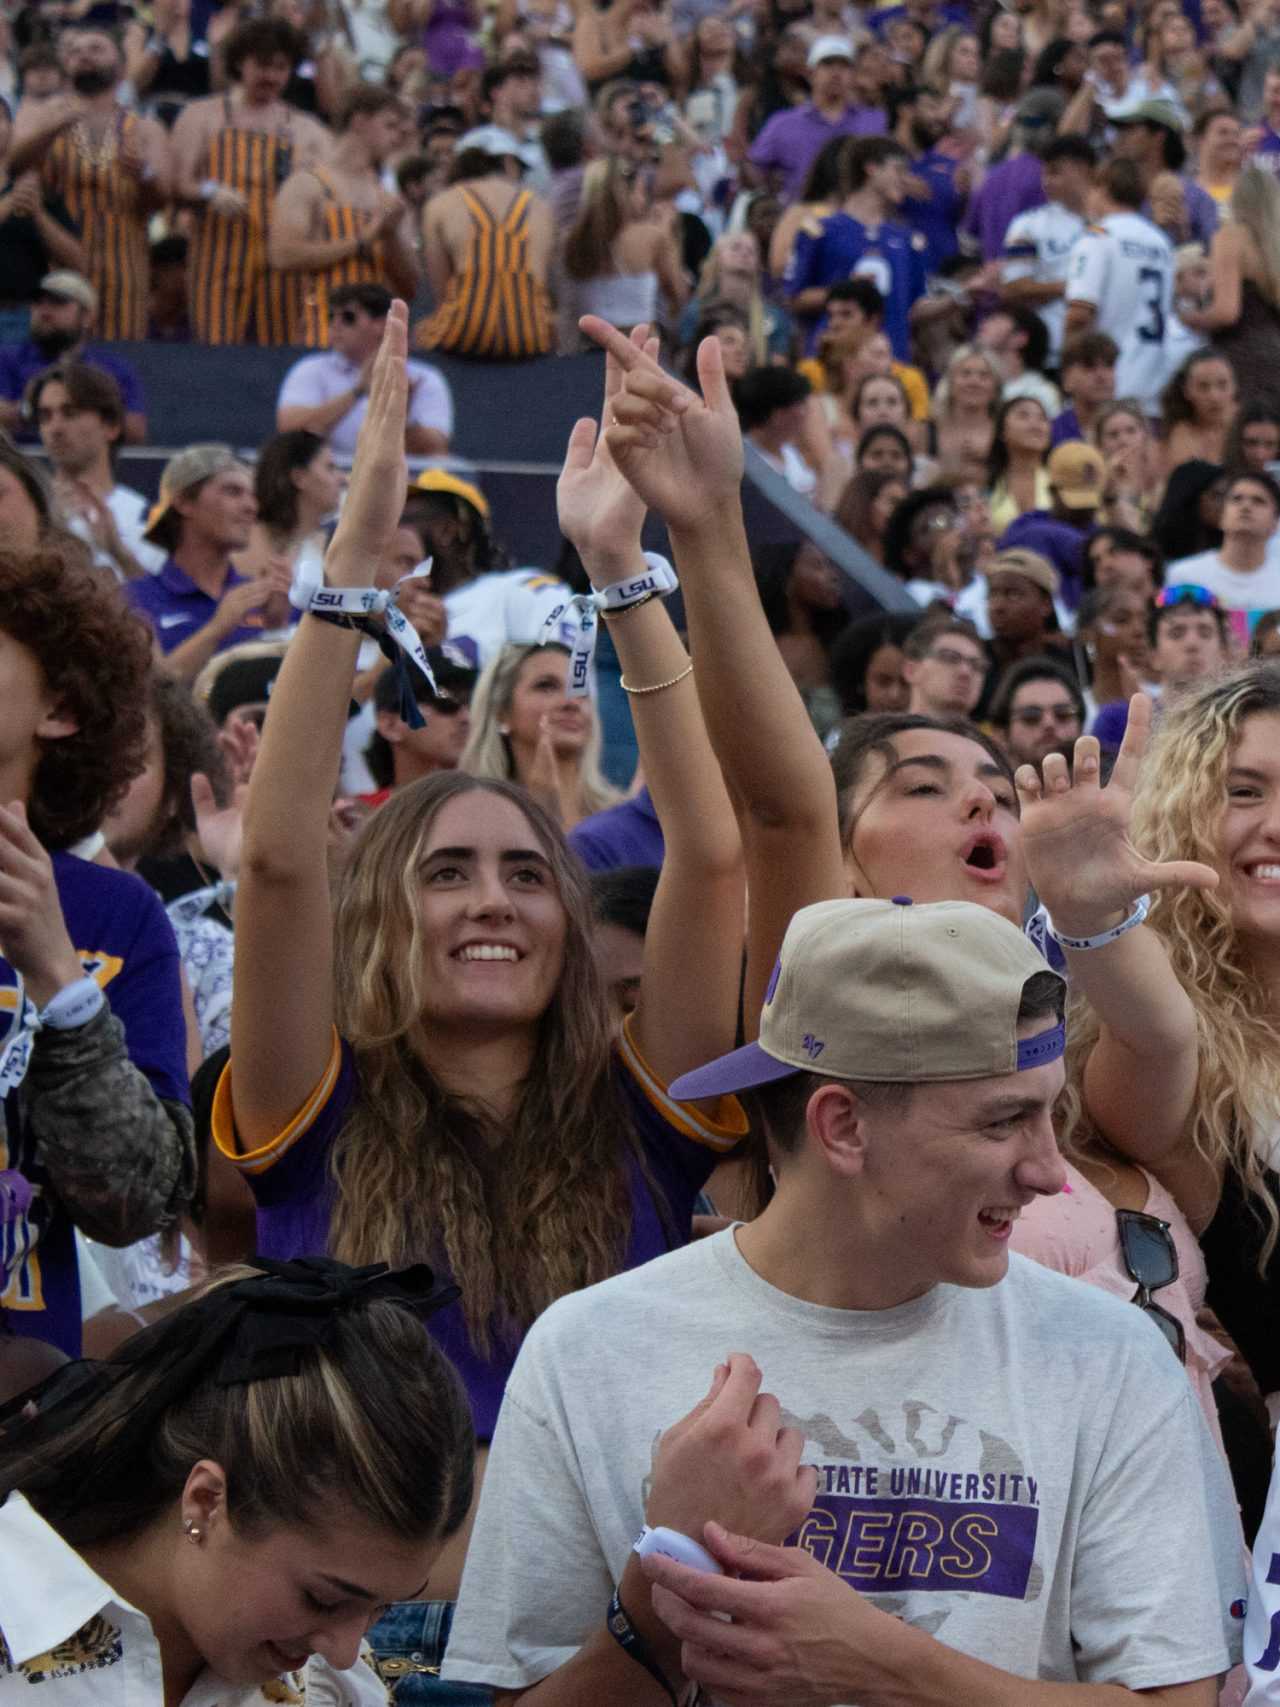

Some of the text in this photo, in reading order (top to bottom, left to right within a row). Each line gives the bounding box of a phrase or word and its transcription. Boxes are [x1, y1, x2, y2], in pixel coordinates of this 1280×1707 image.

[1137, 266, 1165, 342] 3
[619, 577, 657, 600] LSU
[573, 650, 591, 689] LSU
[795, 1508, 998, 1578] GERS
